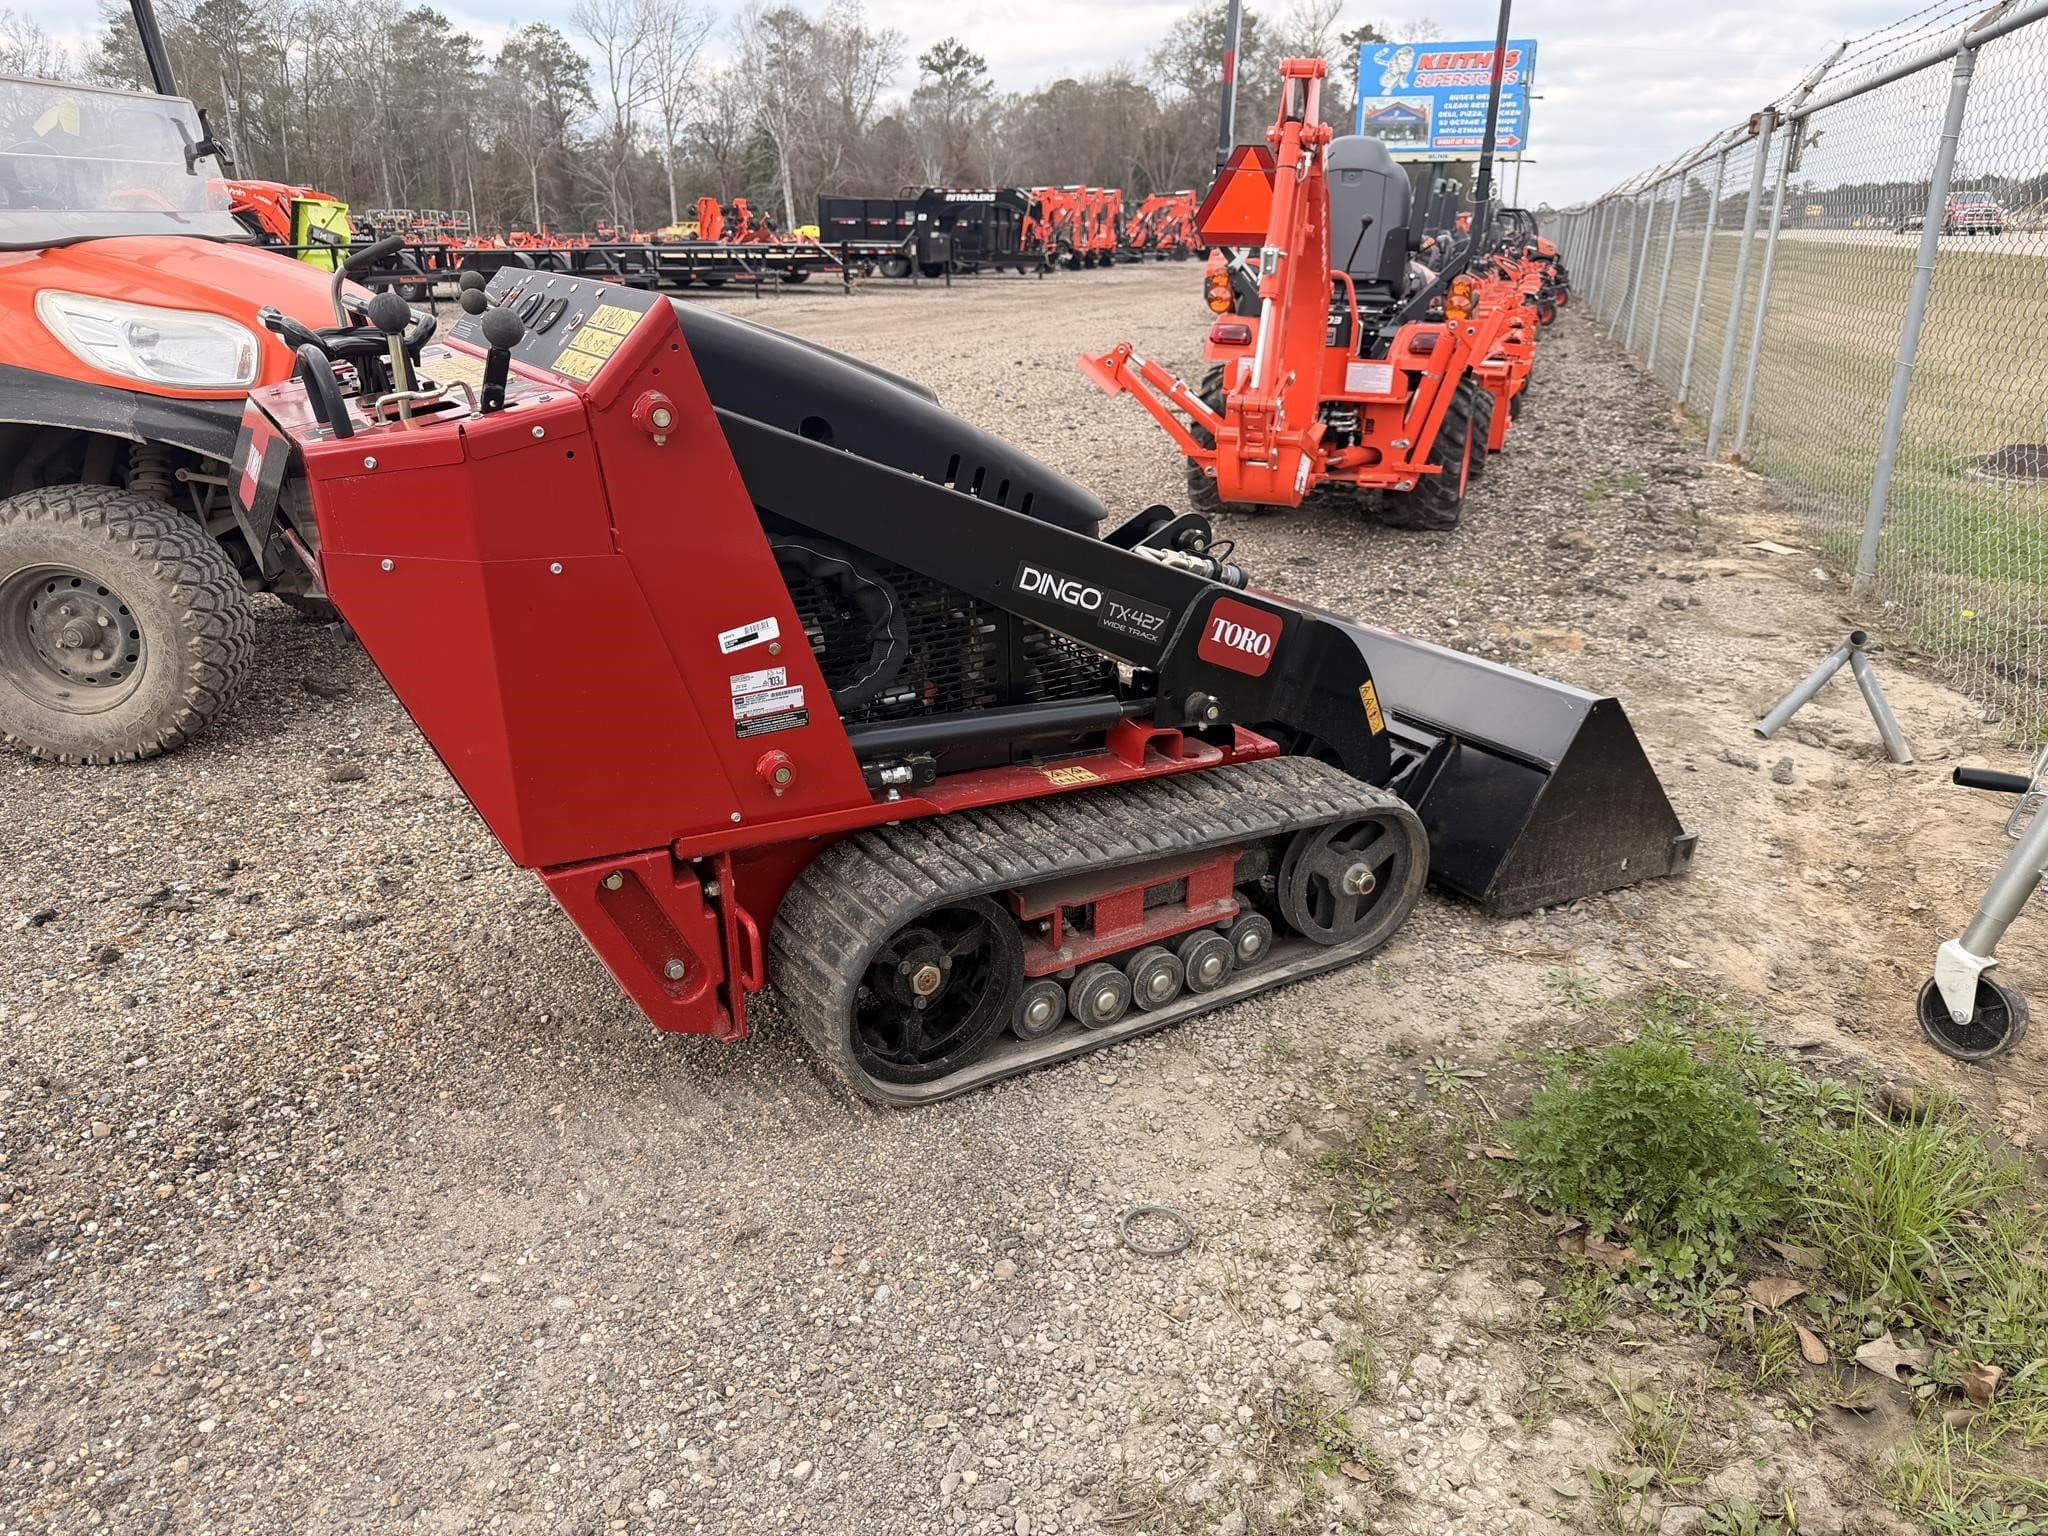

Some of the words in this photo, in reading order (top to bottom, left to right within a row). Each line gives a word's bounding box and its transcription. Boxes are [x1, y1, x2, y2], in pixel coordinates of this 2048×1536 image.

[1416, 51, 1521, 71] KEITHS
[1414, 72, 1519, 87] SUPERSTOES
[1019, 567, 1101, 611] DINGO
[1103, 619, 1126, 632] WIDE
[1128, 627, 1159, 642] TRACK
[1212, 617, 1271, 657] TORO
